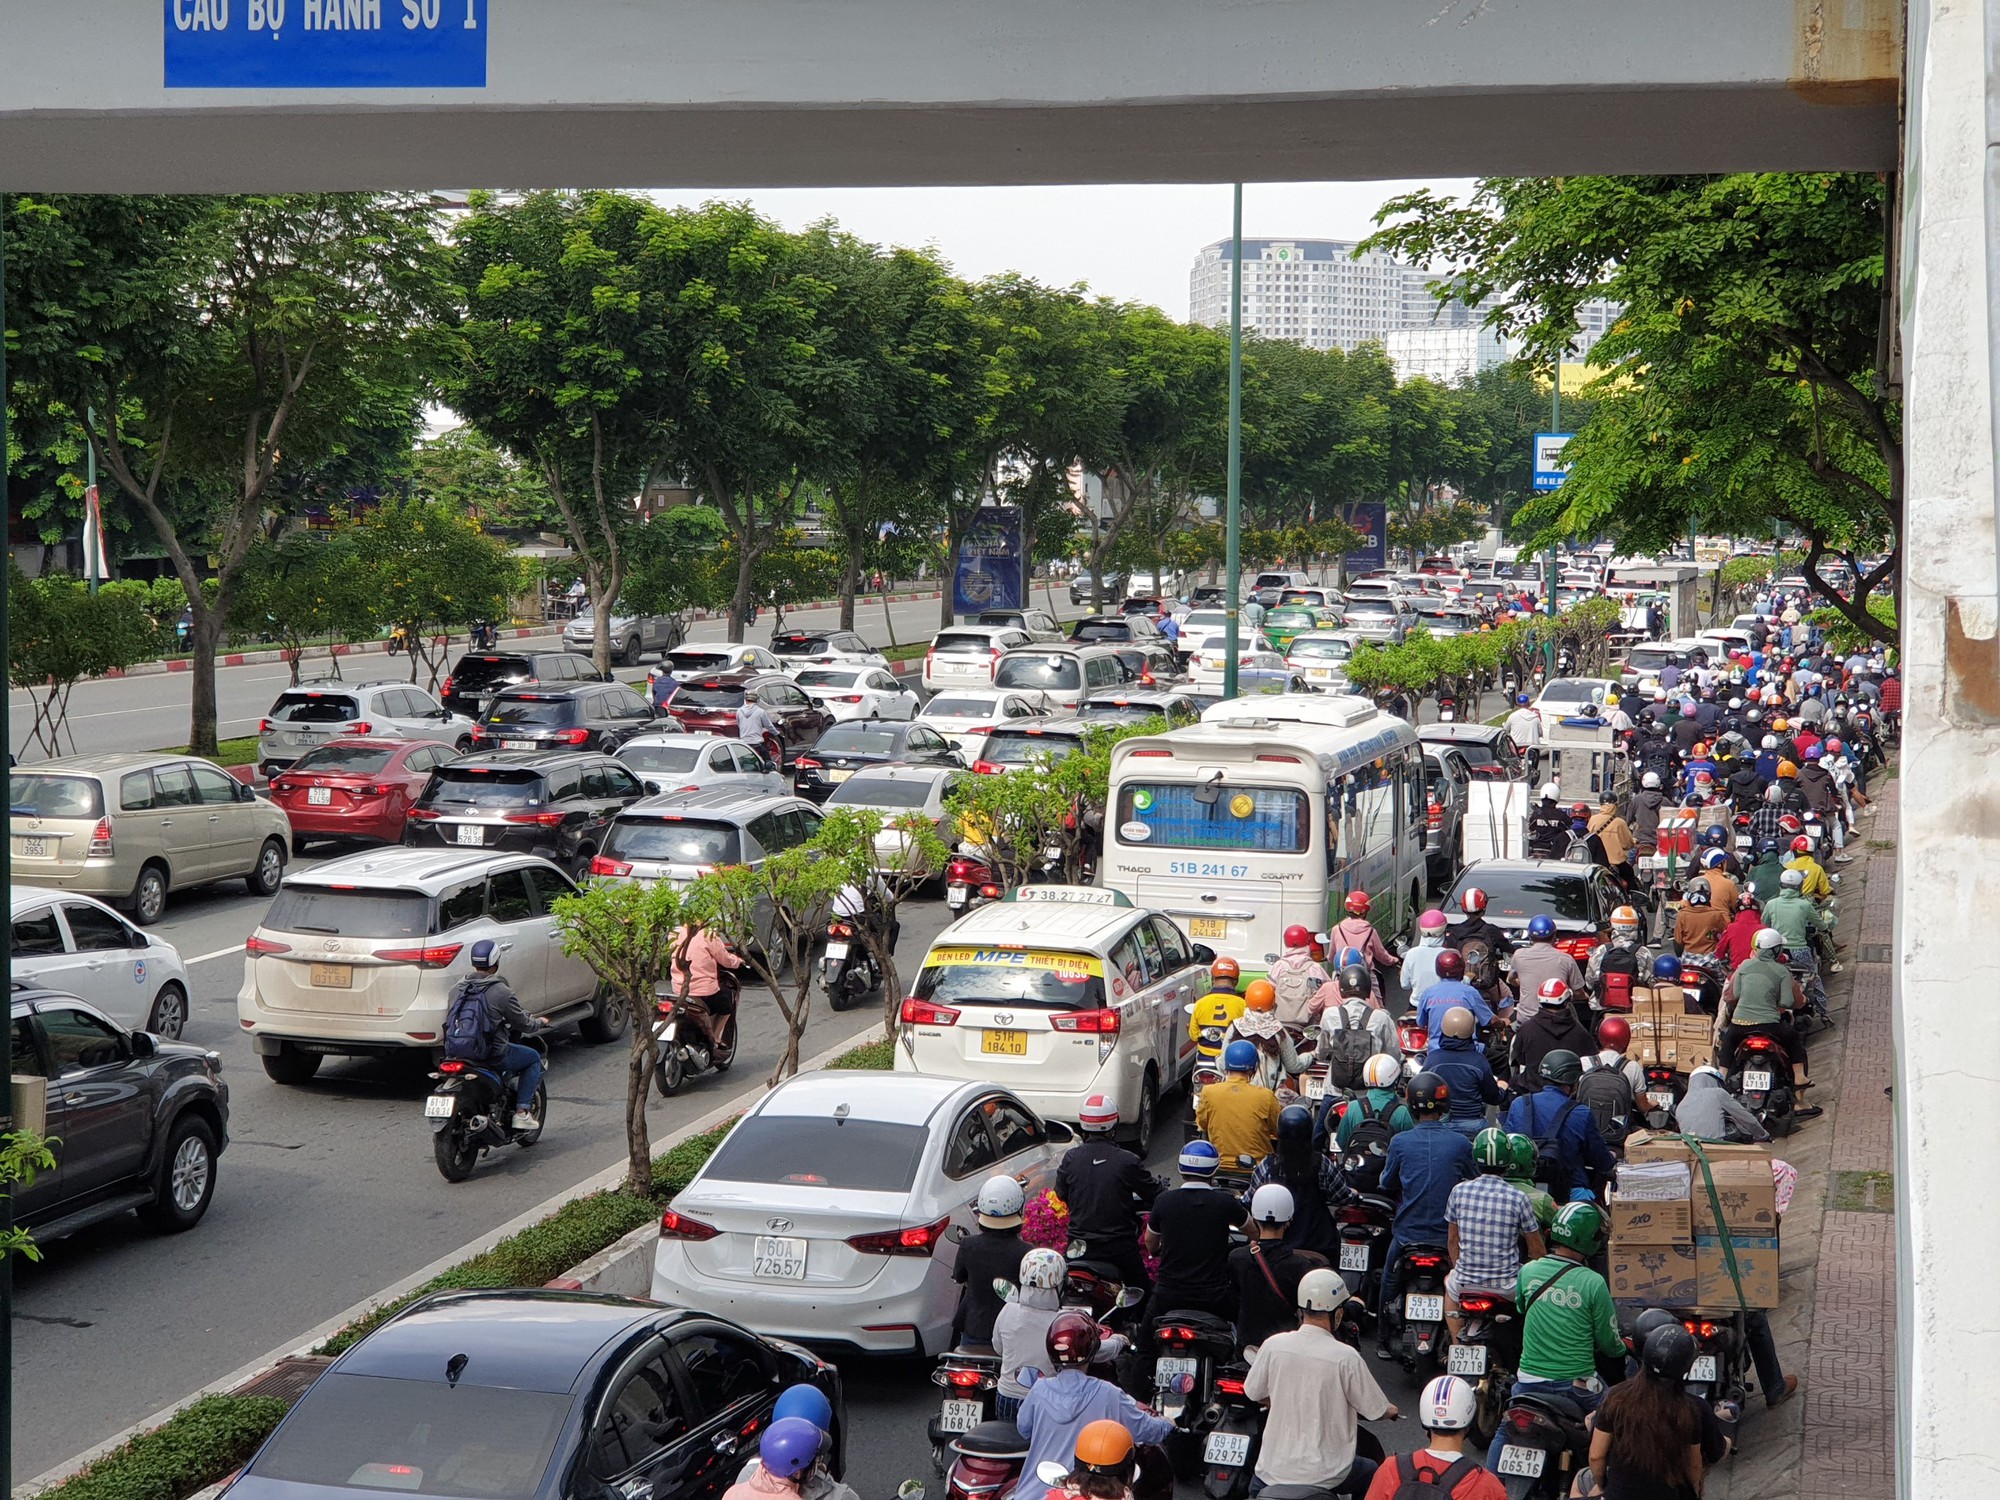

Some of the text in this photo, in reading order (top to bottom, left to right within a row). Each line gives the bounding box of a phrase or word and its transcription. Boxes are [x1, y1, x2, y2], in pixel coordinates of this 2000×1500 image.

[464, 0, 476, 29] 1
[464, 826, 478, 835] 51G
[24, 846, 44, 856] 3953
[1117, 865, 1151, 874] THACO
[1170, 862, 1248, 878] 51B 241 67
[1261, 872, 1304, 881] COUNTY
[1078, 892, 1094, 903] 27
[1096, 893, 1112, 904] 27
[1199, 919, 1216, 929] 51B
[1193, 927, 1222, 938] 241.67
[954, 952, 970, 961] LED
[972, 950, 1027, 964] MPE
[1057, 958, 1067, 969] BỊ
[994, 1031, 1014, 1042] 51H
[988, 1042, 1022, 1054] 184.10
[1628, 1212, 1652, 1226] AXO
[1551, 1224, 1572, 1238] Grab
[767, 1240, 793, 1258] 60A
[755, 1257, 803, 1277] 725.57
[1341, 1257, 1365, 1269] 68.41
[1527, 1279, 1582, 1309] Grab
[1411, 1297, 1438, 1309] 59-X3
[1408, 1308, 1440, 1320] 741.33
[1454, 1348, 1480, 1361] 59-T2
[1162, 1360, 1190, 1373] 59-U1
[1449, 1360, 1482, 1373] 027.18
[1693, 1367, 1714, 1379] 1.49
[949, 1403, 977, 1417] 59-T2
[943, 1416, 979, 1431] 168.41
[1213, 1435, 1243, 1450] 69-B1
[1207, 1448, 1244, 1464] 629.75
[1508, 1446, 1538, 1462] 74-B1
[1501, 1458, 1540, 1475] 065.16
